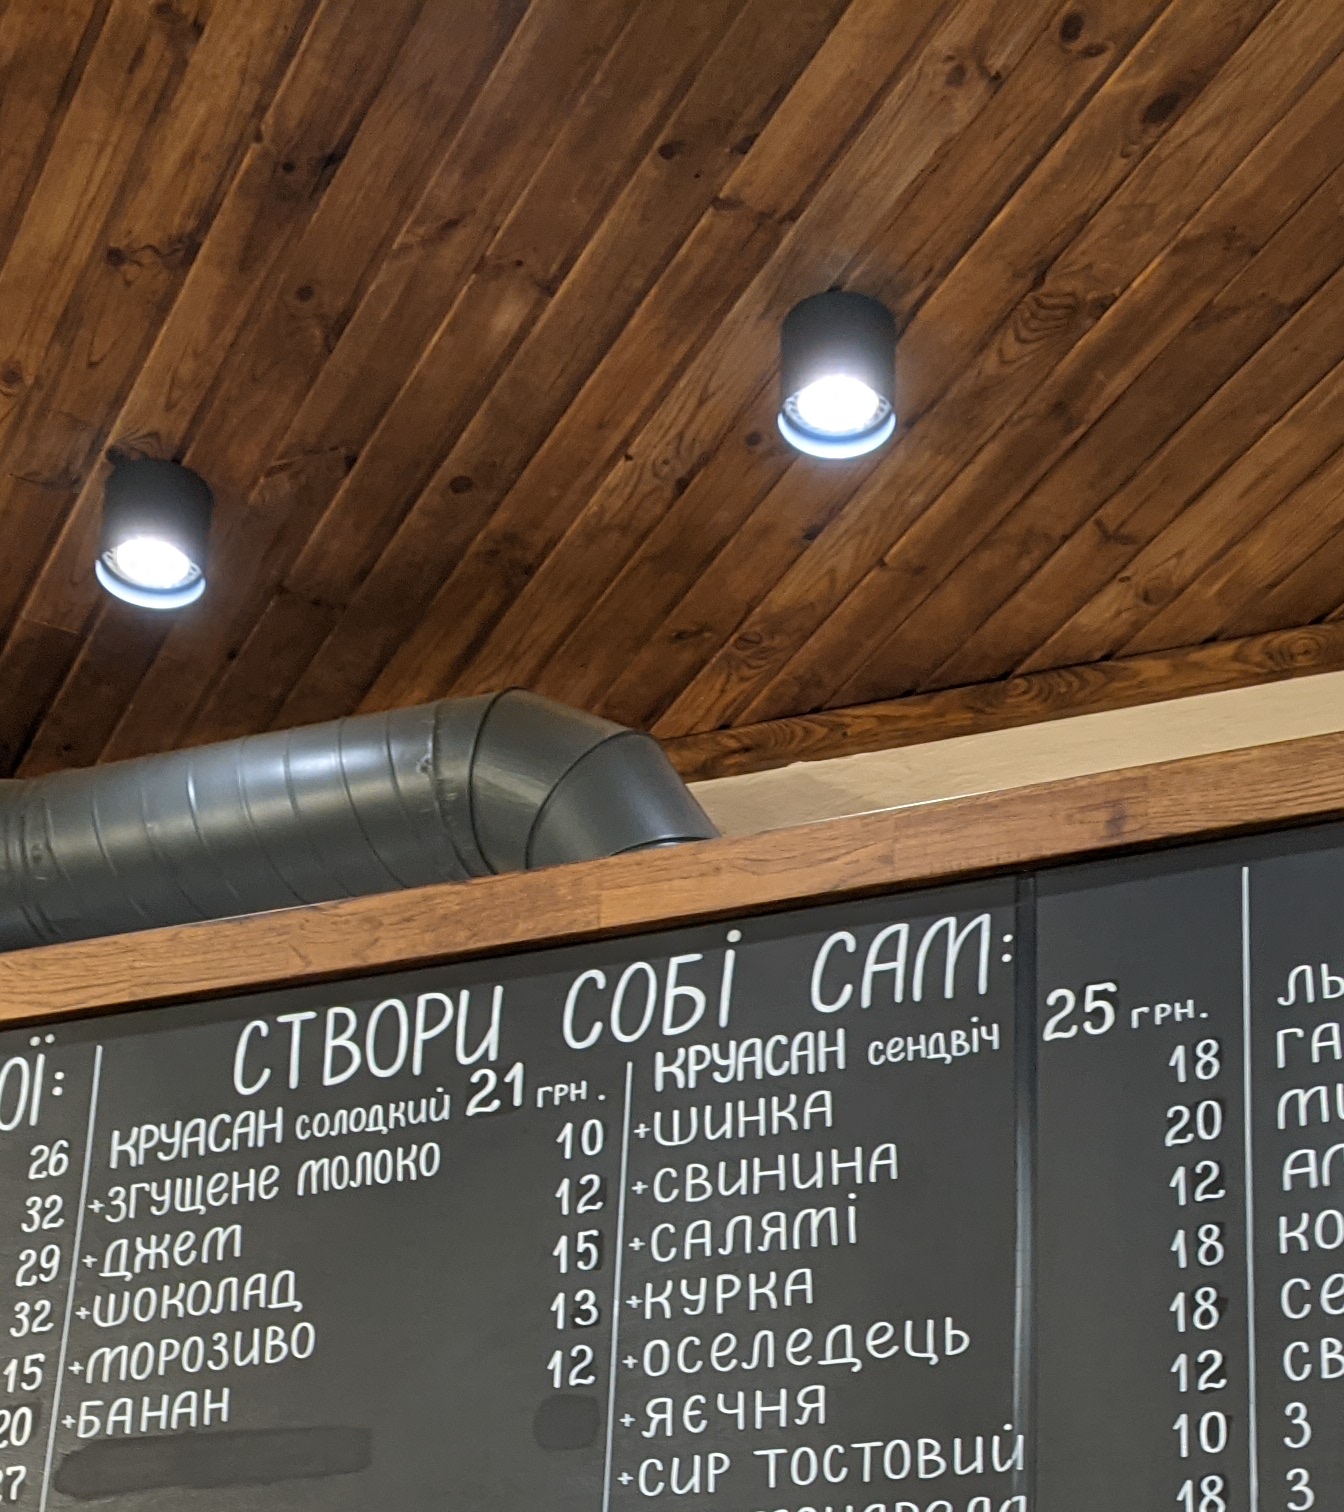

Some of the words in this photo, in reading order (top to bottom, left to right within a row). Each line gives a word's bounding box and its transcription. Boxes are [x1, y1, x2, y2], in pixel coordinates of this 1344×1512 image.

[233, 984, 504, 1096] СТВОРИ
[562, 929, 742, 1050] СОБІ
[810, 912, 1014, 1014] САМ:
[654, 1027, 846, 1093] КРУАСАН
[1042, 981, 1118, 1042] 25
[109, 1105, 284, 1170] КРУАСАН
[465, 1061, 524, 1117] 21
[1164, 1100, 1223, 1148] 20
[296, 1141, 441, 1197] МОЛОКО
[20, 1194, 65, 1233] 32
[554, 1173, 604, 1216] 12
[1170, 1223, 1225, 1269] 18
[9, 1299, 55, 1338] 32
[549, 1288, 599, 1330] 13
[1170, 1349, 1228, 1393] 12
[752, 1423, 1025, 1489] ТОСТОВИЙ
